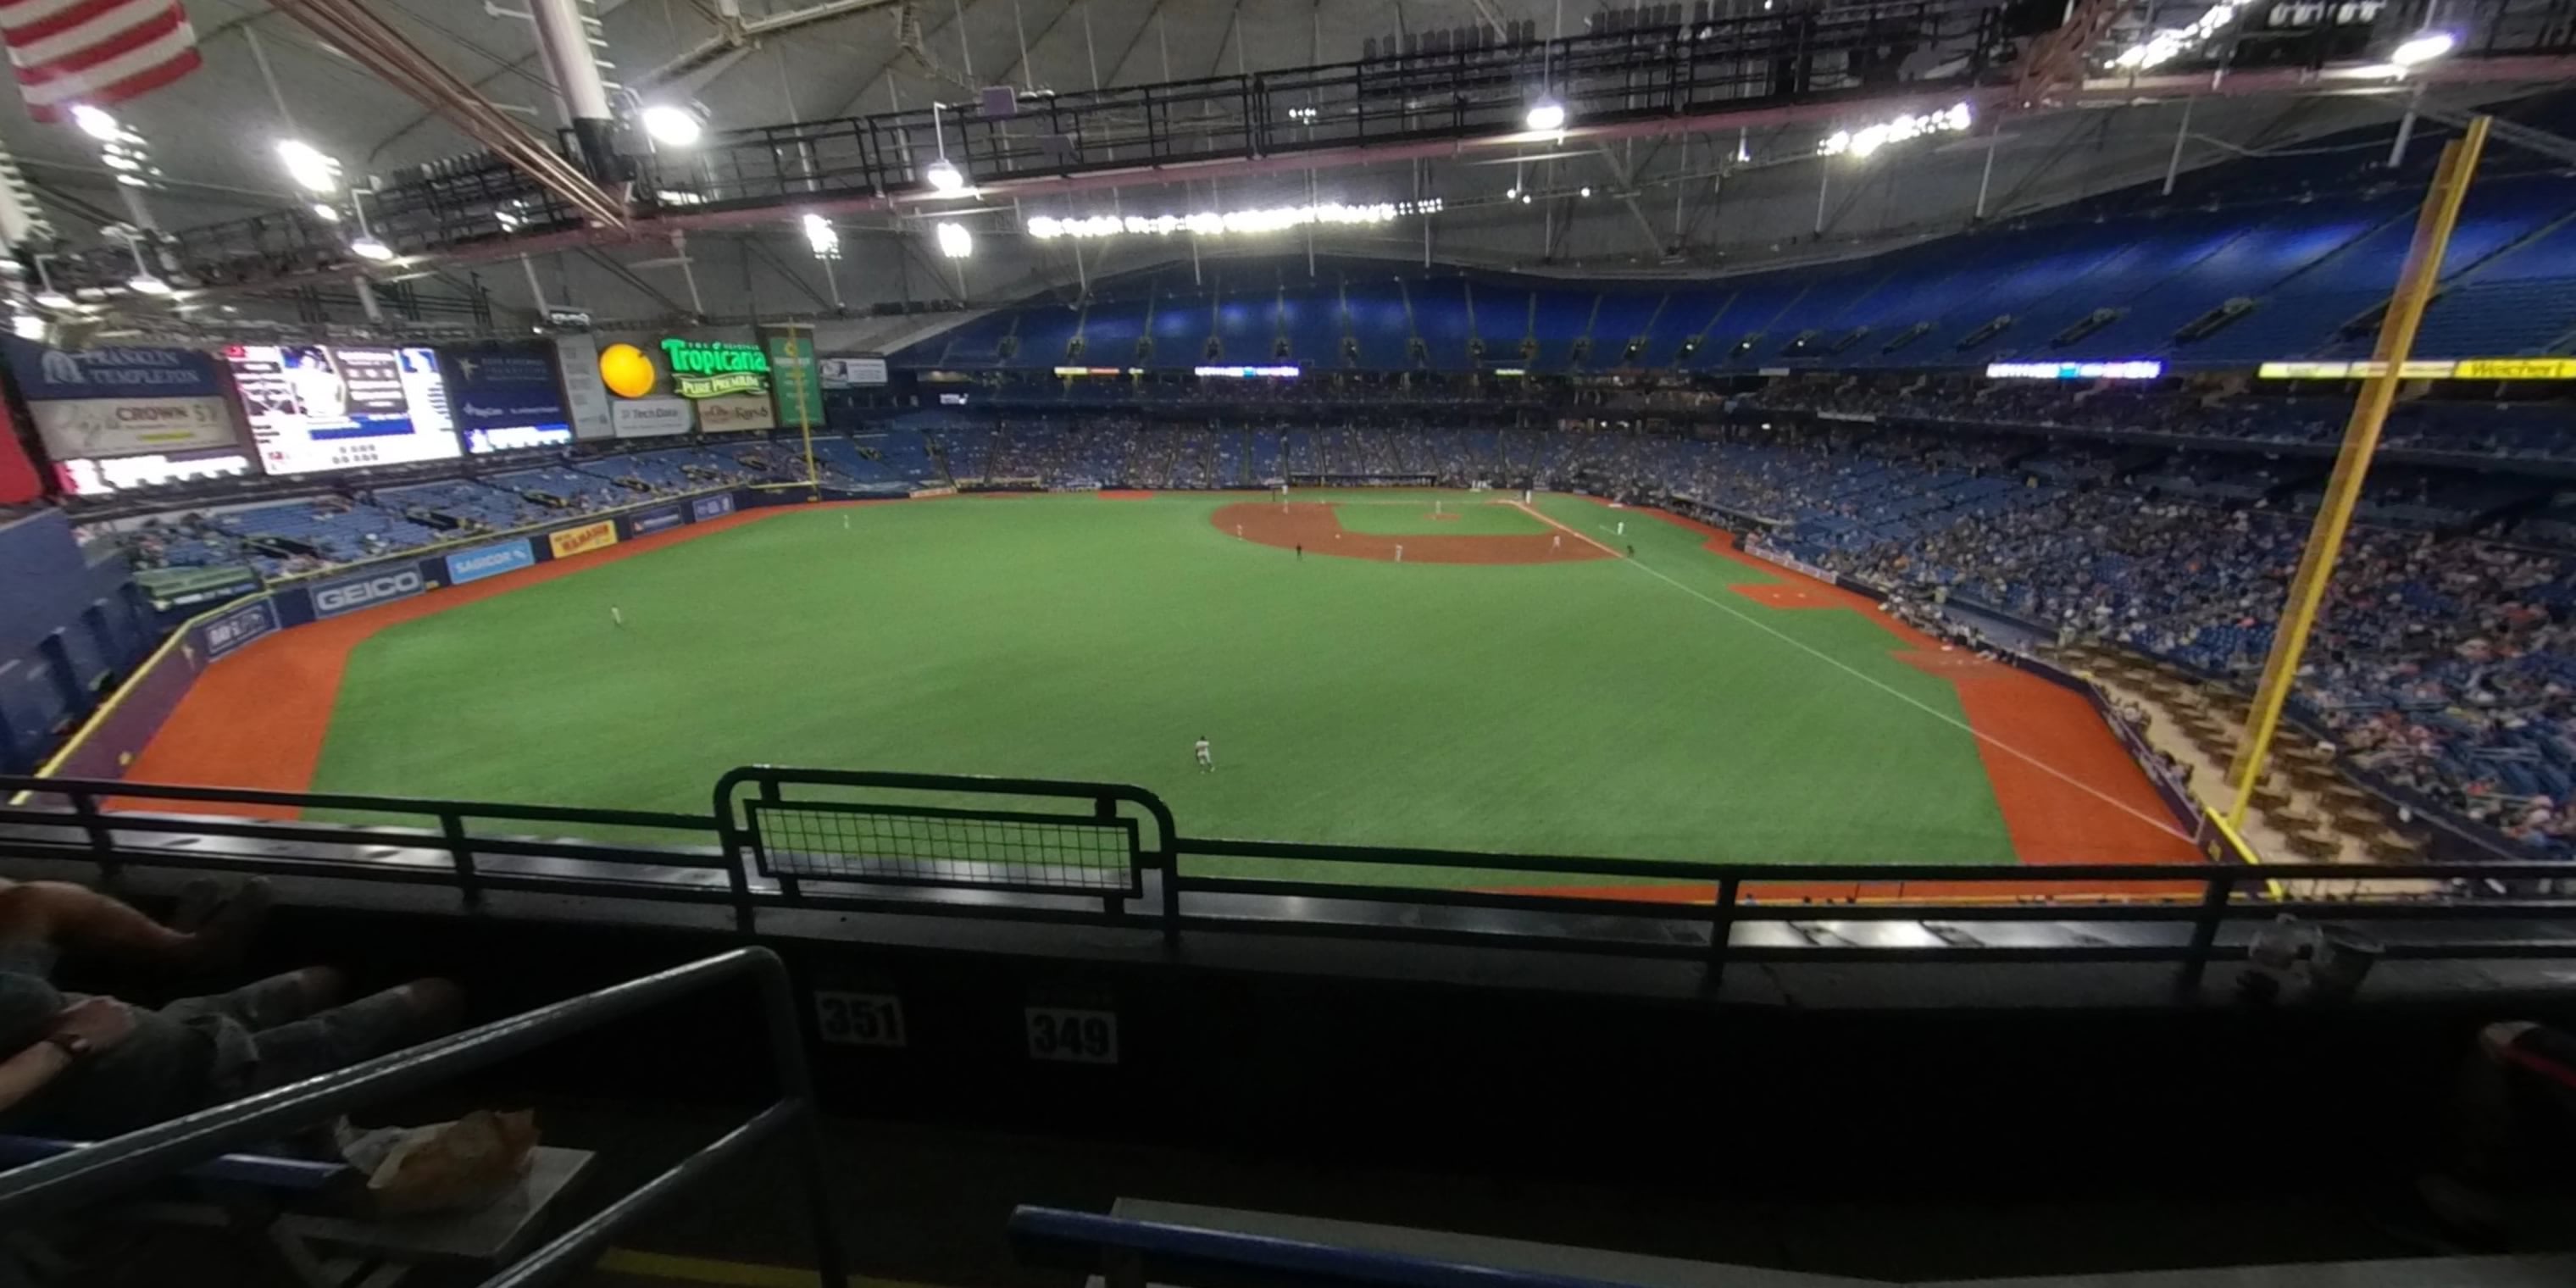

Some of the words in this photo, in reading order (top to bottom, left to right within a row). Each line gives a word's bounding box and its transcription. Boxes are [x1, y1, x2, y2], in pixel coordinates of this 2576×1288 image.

[661, 339, 768, 375] Tropicana
[316, 571, 420, 611] GEICO
[821, 997, 896, 1039] 351
[1032, 1013, 1110, 1057] 349
